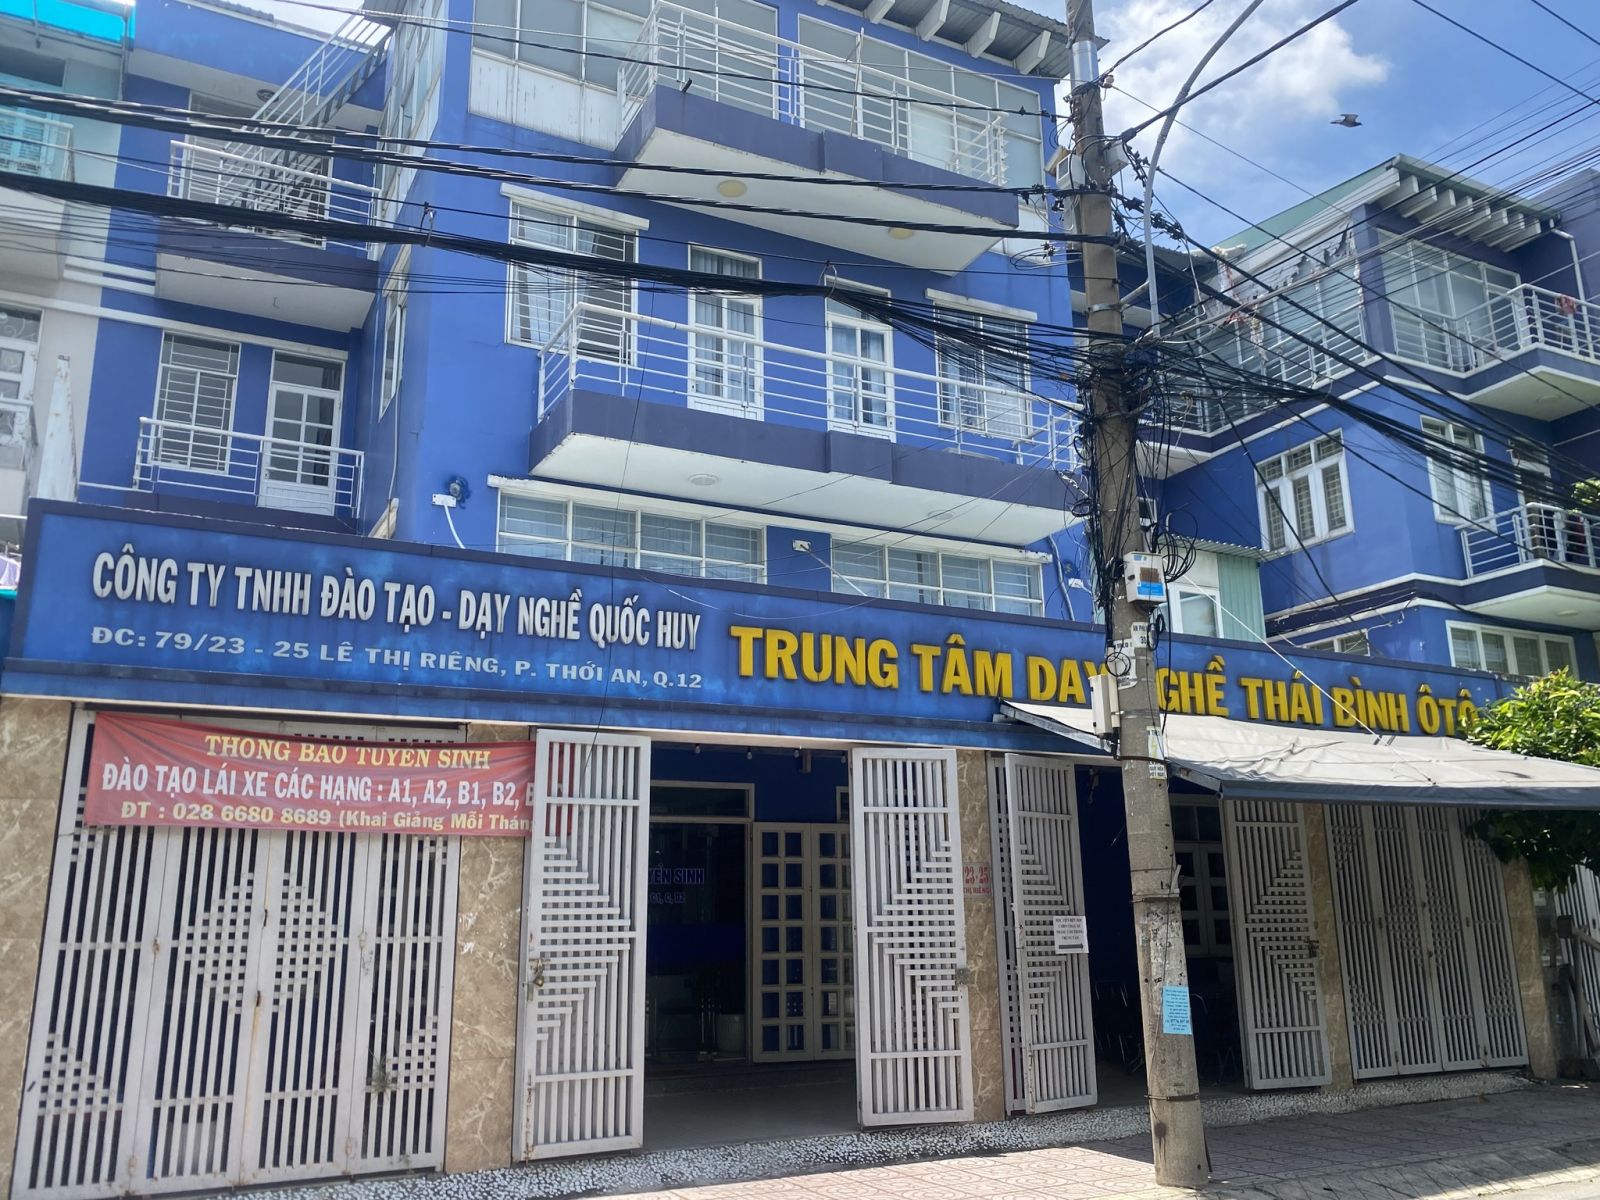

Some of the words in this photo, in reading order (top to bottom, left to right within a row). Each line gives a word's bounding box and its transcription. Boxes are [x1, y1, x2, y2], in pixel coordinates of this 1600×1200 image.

[92, 543, 178, 604] CÔNG
[187, 562, 226, 608] TY
[234, 566, 312, 616] TNHH
[320, 567, 376, 621] ĐÀO
[384, 582, 435, 633] TẠO
[458, 590, 511, 639] DẠY
[517, 589, 583, 640] NGHỀ
[588, 595, 650, 649] QUỐC
[656, 610, 700, 651] HUY
[91, 626, 146, 648] ĐC:
[154, 631, 245, 655] 79/23
[272, 641, 310, 660] 25
[319, 641, 354, 663] LÊ
[364, 647, 411, 671] THỊ
[420, 651, 507, 677] RIÊNG,
[515, 660, 537, 677] P.
[545, 660, 603, 683] THỚI
[610, 668, 648, 687] AN,
[653, 672, 703, 690] Q.12
[730, 625, 899, 690] TRUNG
[911, 633, 1014, 700] TÂM
[1240, 670, 1325, 726] THÁI
[1332, 676, 1411, 733] BÌNH
[102, 756, 148, 791] ĐÀO
[155, 765, 197, 798] TẠO
[202, 762, 237, 796] LÁI
[242, 770, 269, 797] XE
[274, 767, 313, 800] CÁC
[319, 774, 371, 806] HẠNG
[388, 778, 418, 808] A1,
[423, 779, 451, 809] A2,
[458, 781, 486, 810] B1,
[492, 781, 520, 811] B2,
[437, 750, 491, 770] SINH
[121, 801, 151, 818] ĐT
[172, 803, 214, 820] 028
[220, 805, 274, 822] 6680
[280, 808, 331, 825] 8689
[339, 810, 387, 828] (Khai
[393, 810, 446, 831] Giảng
[450, 810, 483, 830] Mỗi
